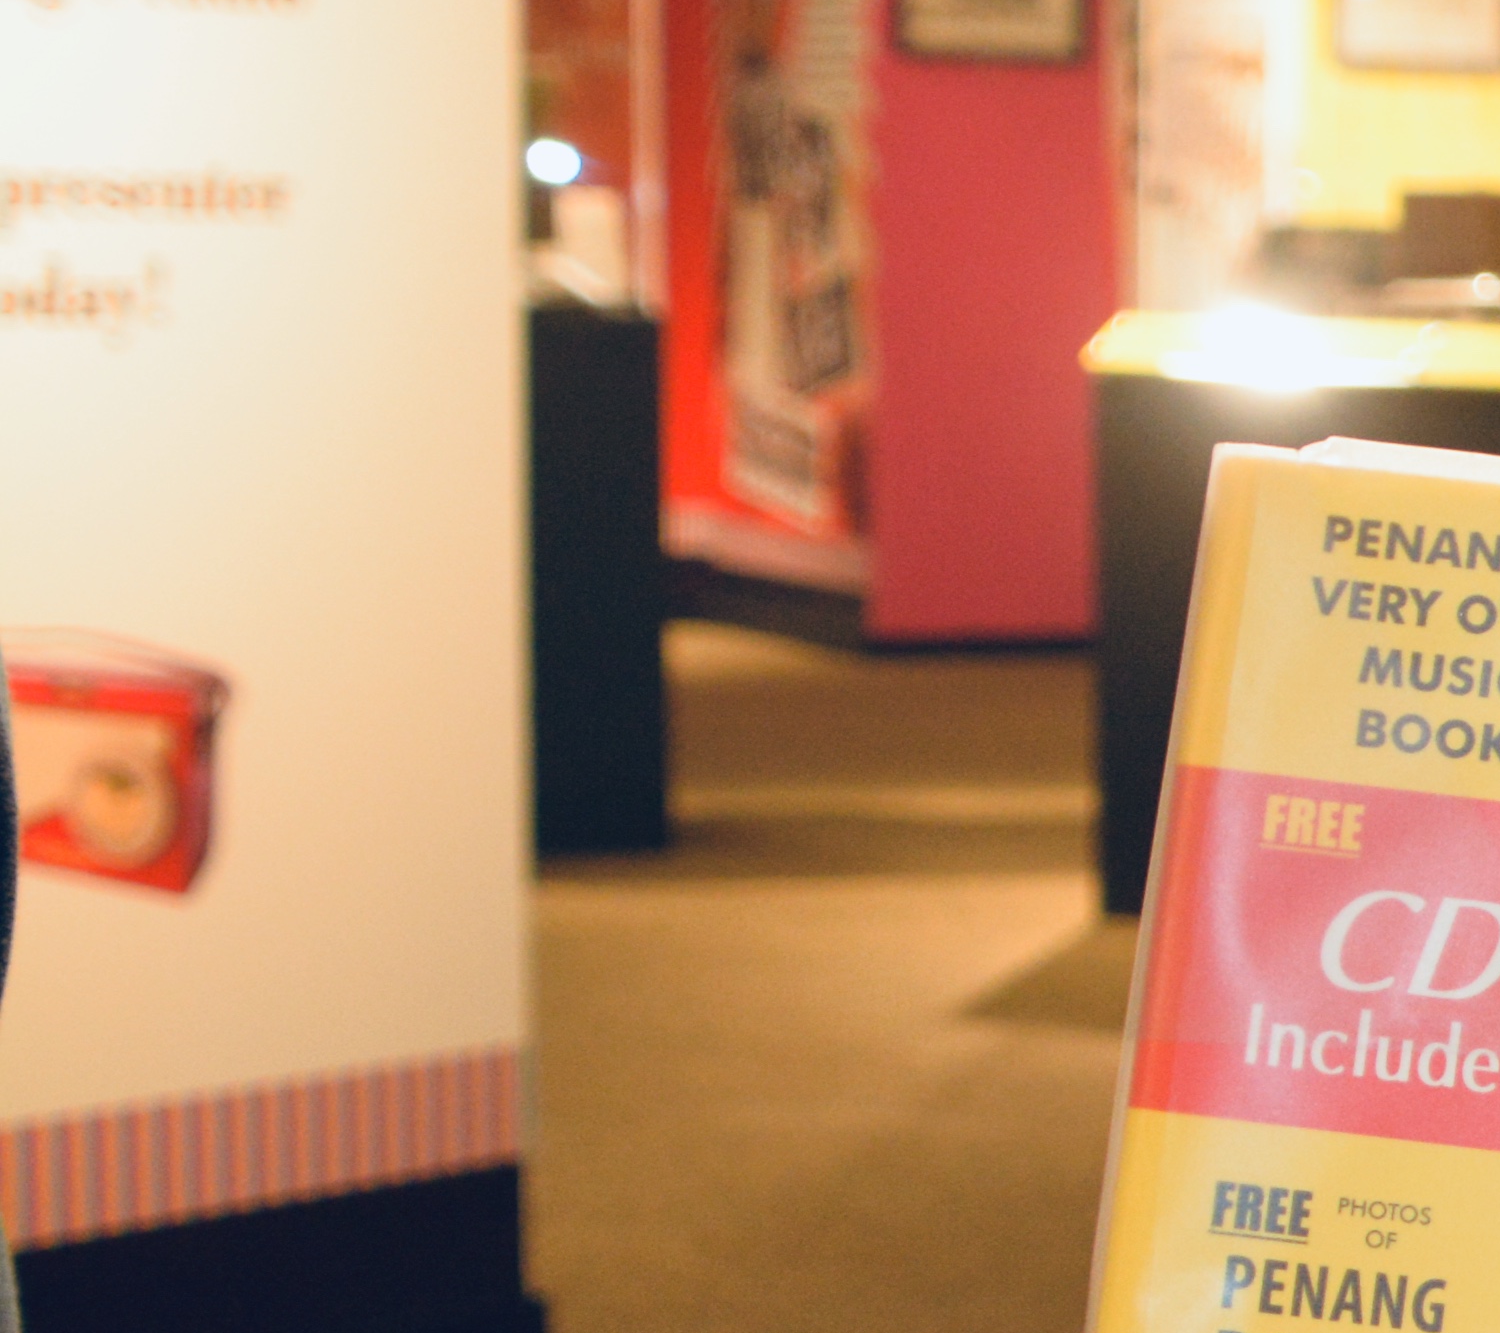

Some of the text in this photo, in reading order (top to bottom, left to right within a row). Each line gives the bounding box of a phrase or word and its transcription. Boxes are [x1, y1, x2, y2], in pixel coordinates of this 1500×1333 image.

[1312, 576, 1442, 628] VERY
[1262, 794, 1365, 852] FREE
[1211, 1180, 1432, 1238] FREE PHOTOS
[1364, 1228, 1398, 1250] OF
